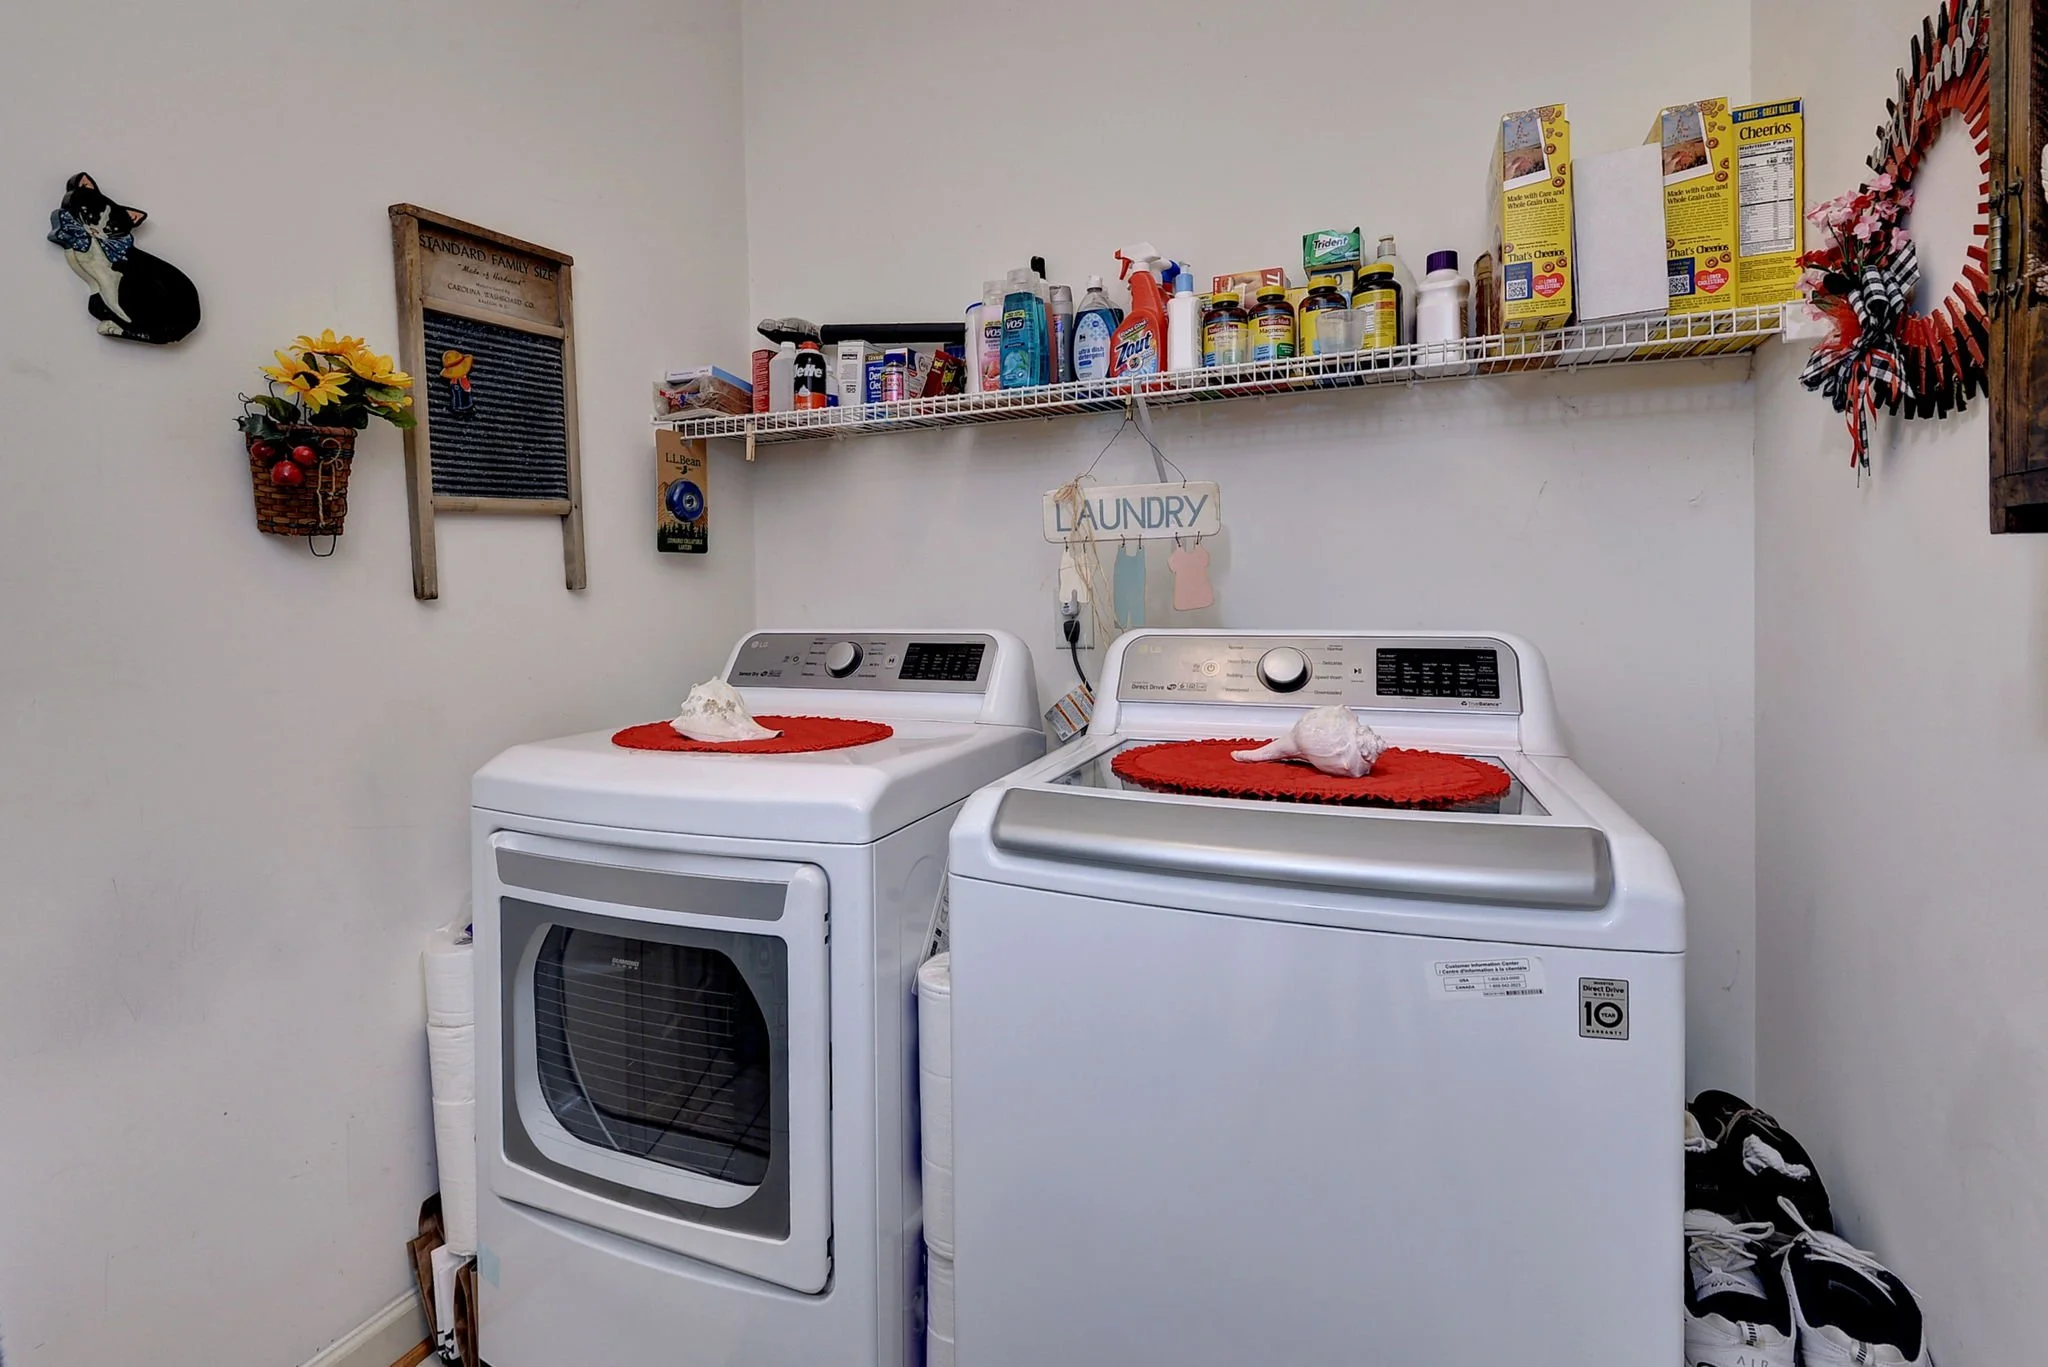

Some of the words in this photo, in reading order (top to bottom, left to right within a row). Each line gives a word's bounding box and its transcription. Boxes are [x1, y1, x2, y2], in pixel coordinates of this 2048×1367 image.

[1739, 122, 1792, 140] Cheerios
[1739, 142, 1771, 150] Nutrition
[1685, 186, 1699, 194] with
[1314, 237, 1348, 249] Trident
[1669, 247, 1694, 258] That's
[1696, 243, 1729, 254] Cheerios
[419, 235, 486, 262] STANDARD
[492, 254, 529, 275] FAMILY
[534, 266, 553, 281] SIZE
[1508, 251, 1533, 262] That's
[1534, 247, 1565, 259] Cheerios
[447, 283, 480, 297] CAROLINA
[1006, 319, 1023, 330] VO5
[1115, 331, 1152, 370] Zout
[665, 452, 701, 468] L.L.Bean
[1056, 494, 1208, 533] LAUNDRY
[1460, 966, 1494, 974] d'information
[1582, 984, 1604, 993] Direct
[1605, 986, 1625, 994] Drive
[1584, 1000, 1624, 1029] 10
